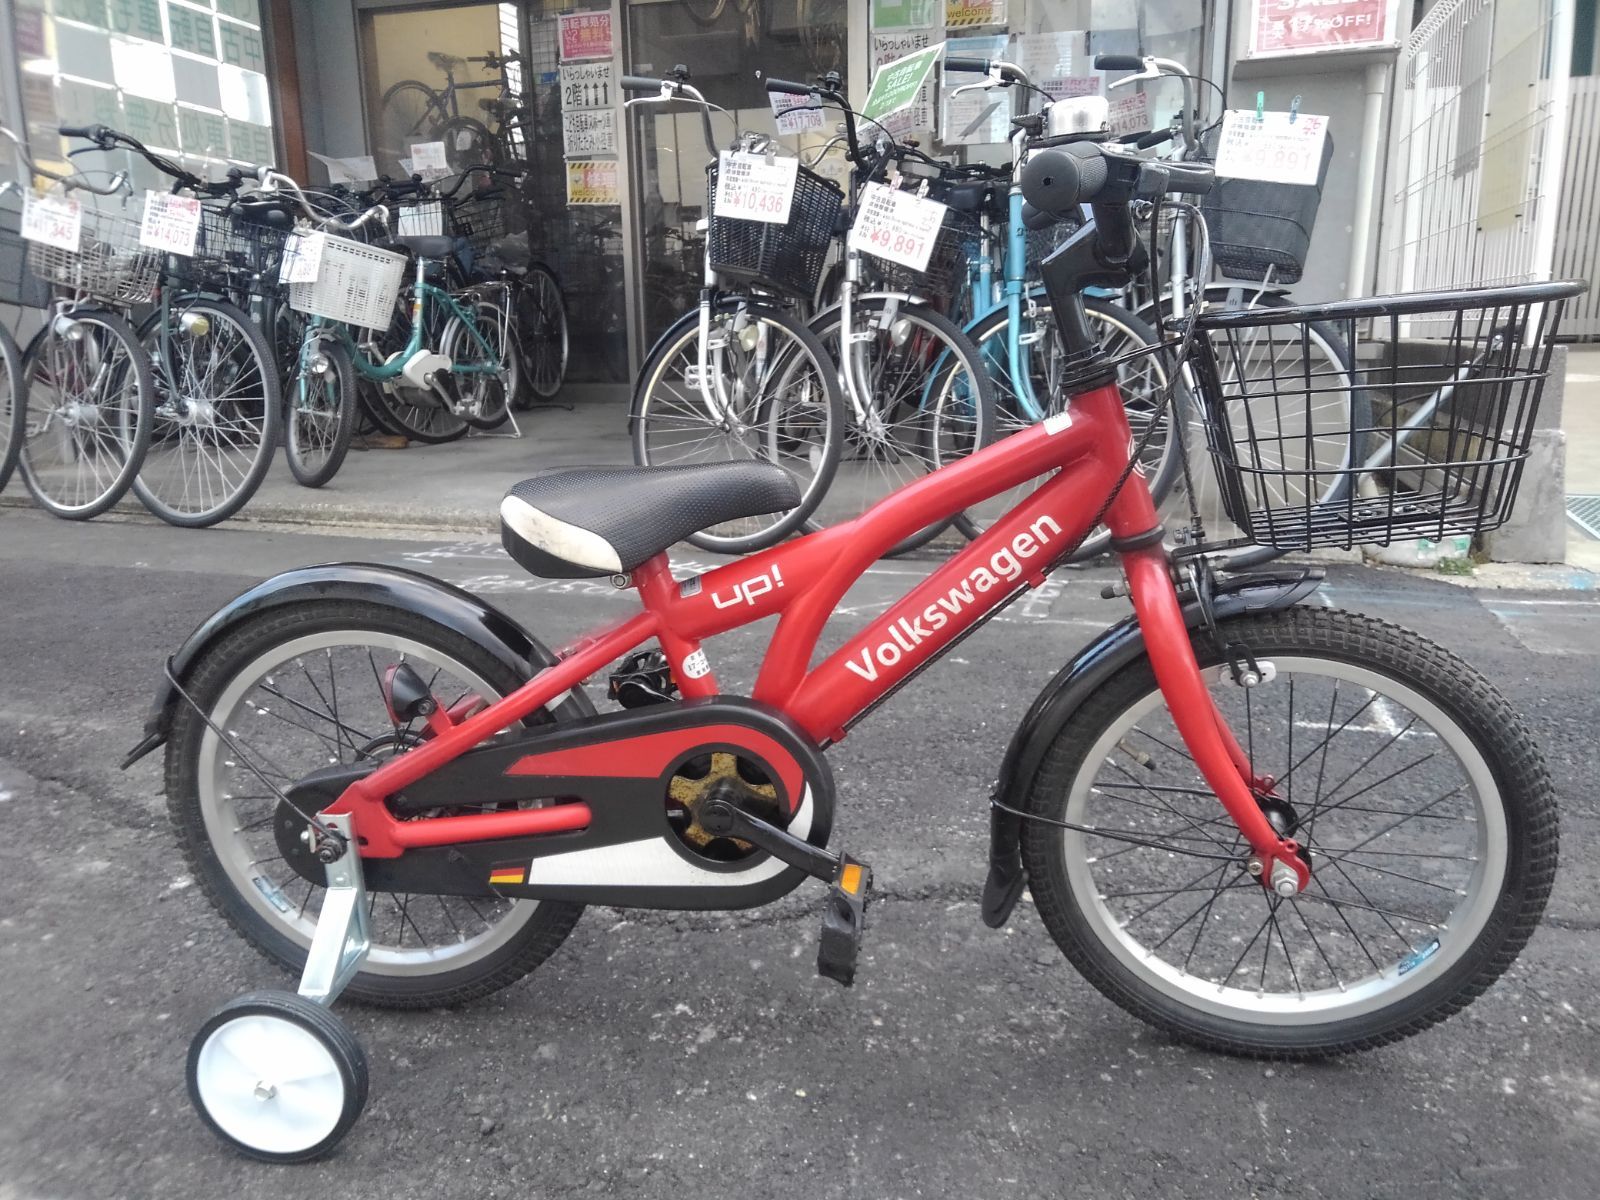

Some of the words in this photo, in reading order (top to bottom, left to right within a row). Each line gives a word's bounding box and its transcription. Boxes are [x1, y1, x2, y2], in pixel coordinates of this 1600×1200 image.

[947, 7, 993, 18] welcome
[874, 33, 929, 52] いらっしゃいませ
[562, 65, 609, 81] いらっしゃいませ
[565, 82, 583, 107] 2階
[733, 191, 784, 213] ¥10,436
[153, 226, 191, 247] ¥14,073
[870, 227, 925, 259] ¥9,891
[711, 563, 784, 610] up!
[844, 514, 1062, 683] Volkswagen
